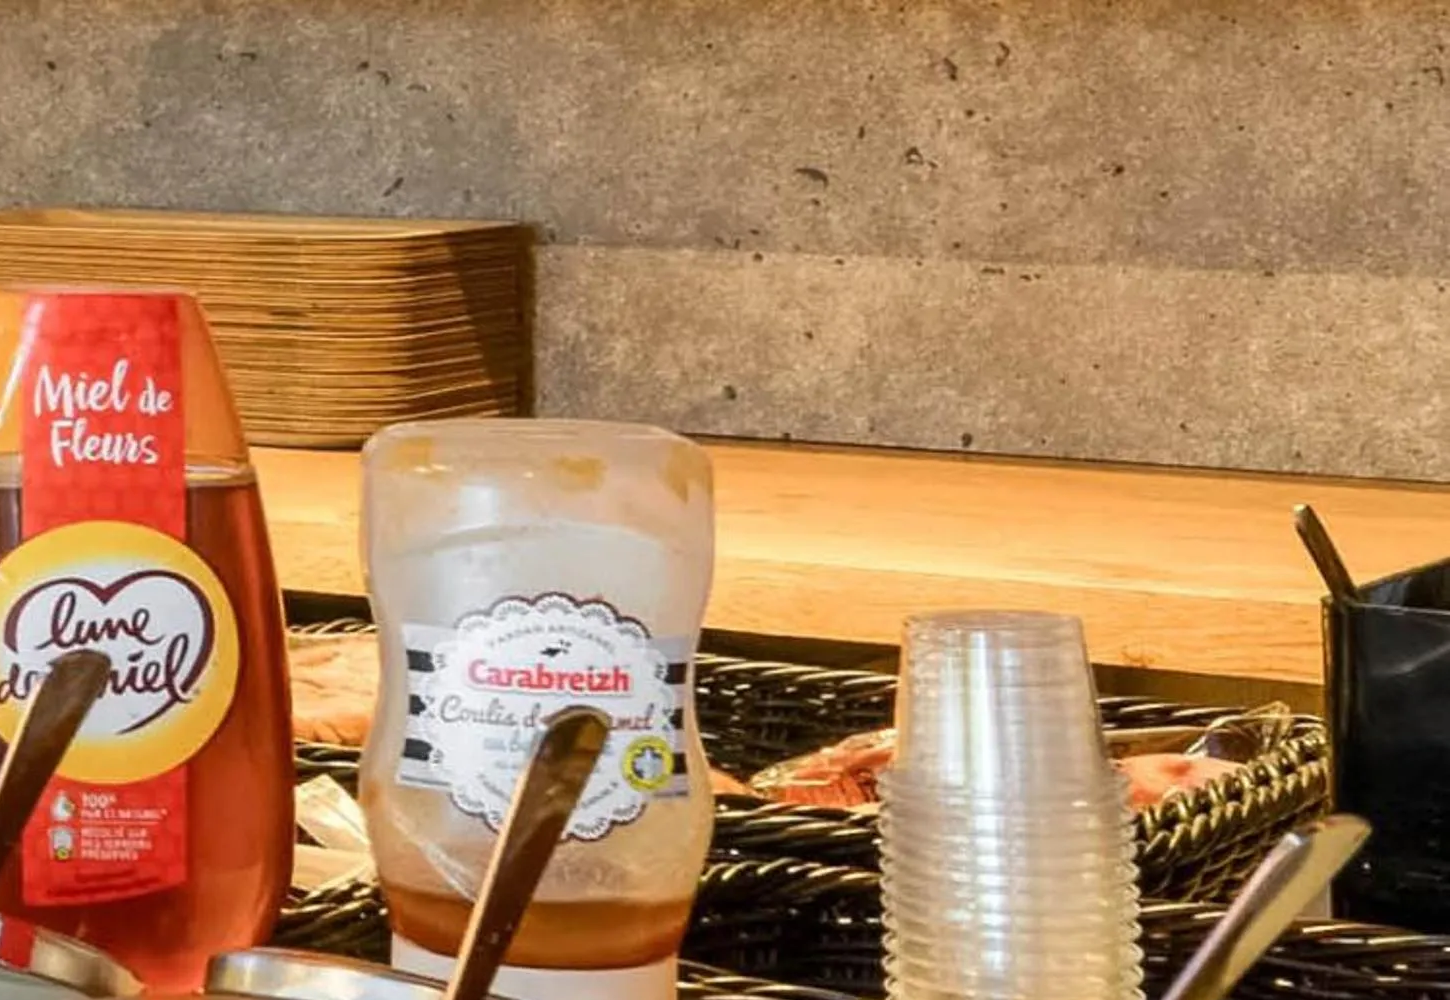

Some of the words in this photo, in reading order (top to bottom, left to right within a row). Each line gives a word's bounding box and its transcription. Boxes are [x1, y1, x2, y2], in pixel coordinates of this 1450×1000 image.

[34, 358, 130, 418] Miel
[138, 376, 173, 416] de
[51, 417, 159, 468] Fleurs
[468, 660, 629, 691] Carabreizh
[440, 695, 518, 726] Coulis
